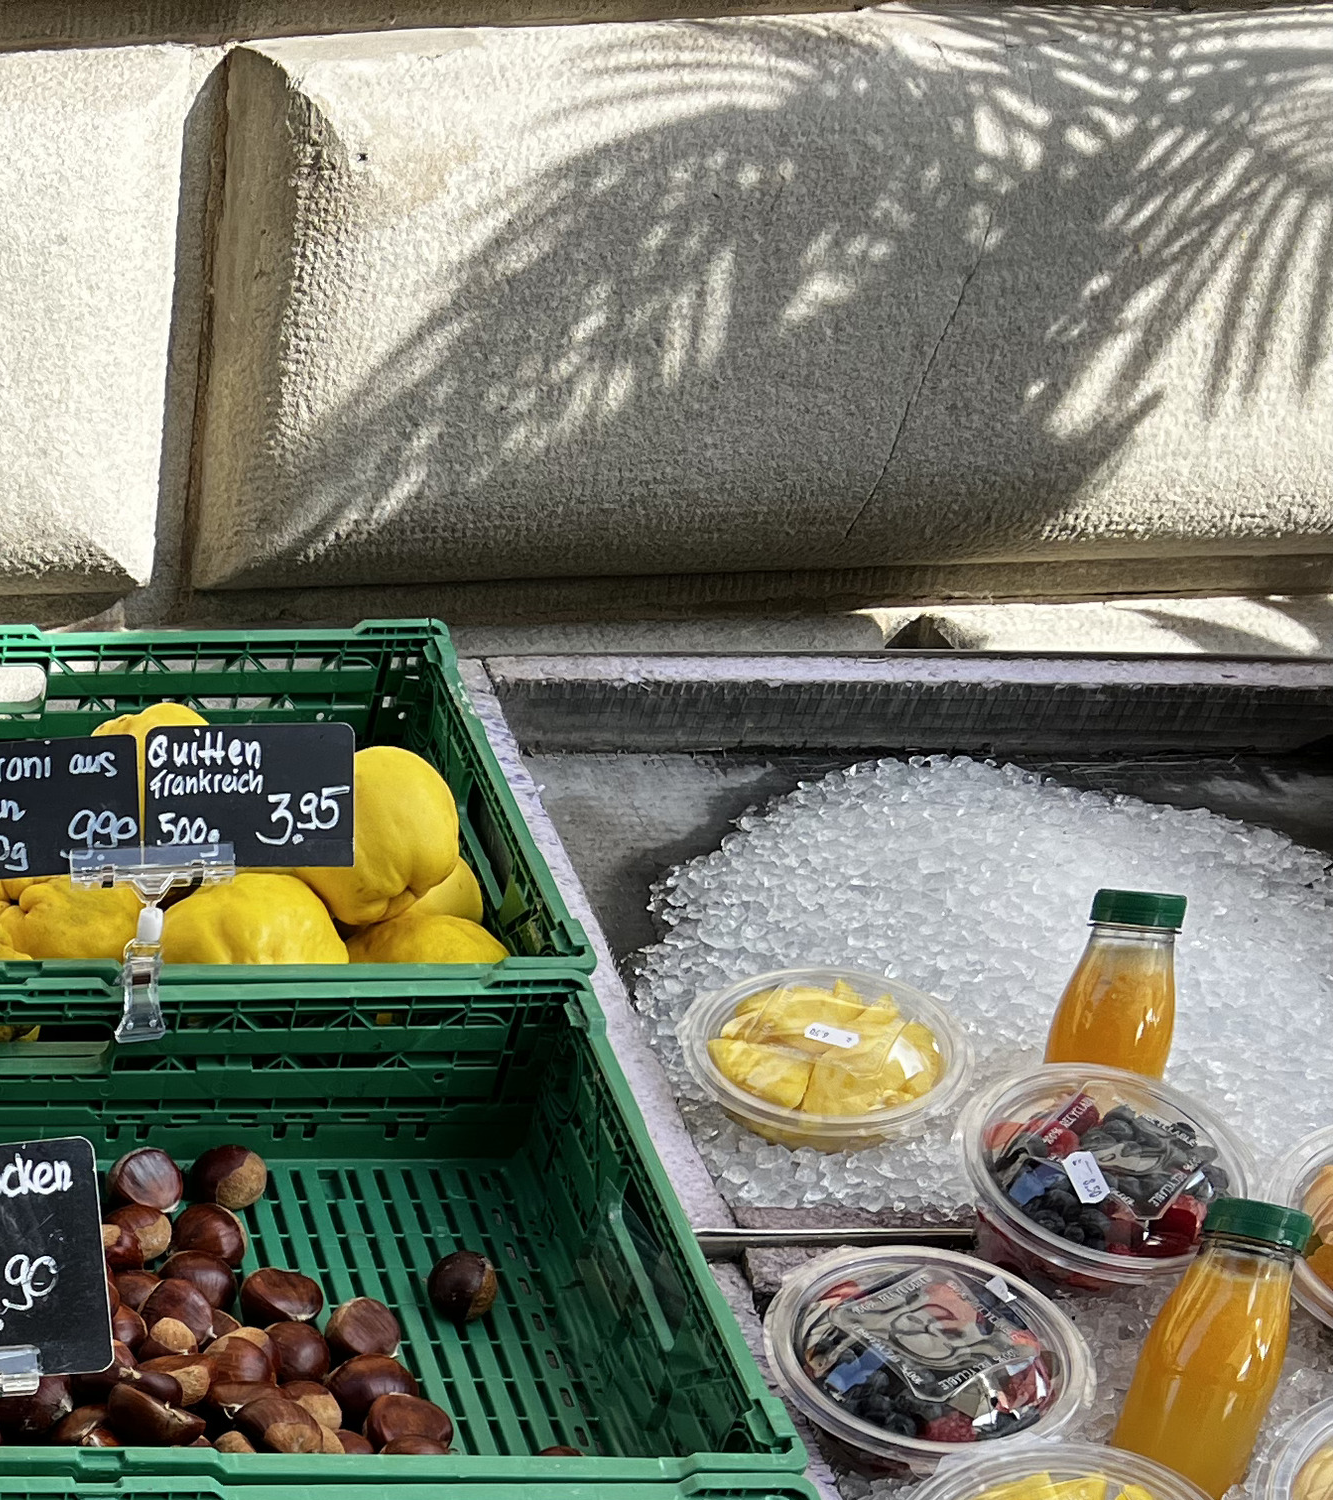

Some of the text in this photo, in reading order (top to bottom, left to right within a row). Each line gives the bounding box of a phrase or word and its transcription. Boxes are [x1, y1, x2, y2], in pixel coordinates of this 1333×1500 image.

[68, 751, 119, 778] aus
[147, 729, 262, 769] Quitten
[156, 785, 350, 858] 500g 3.95
